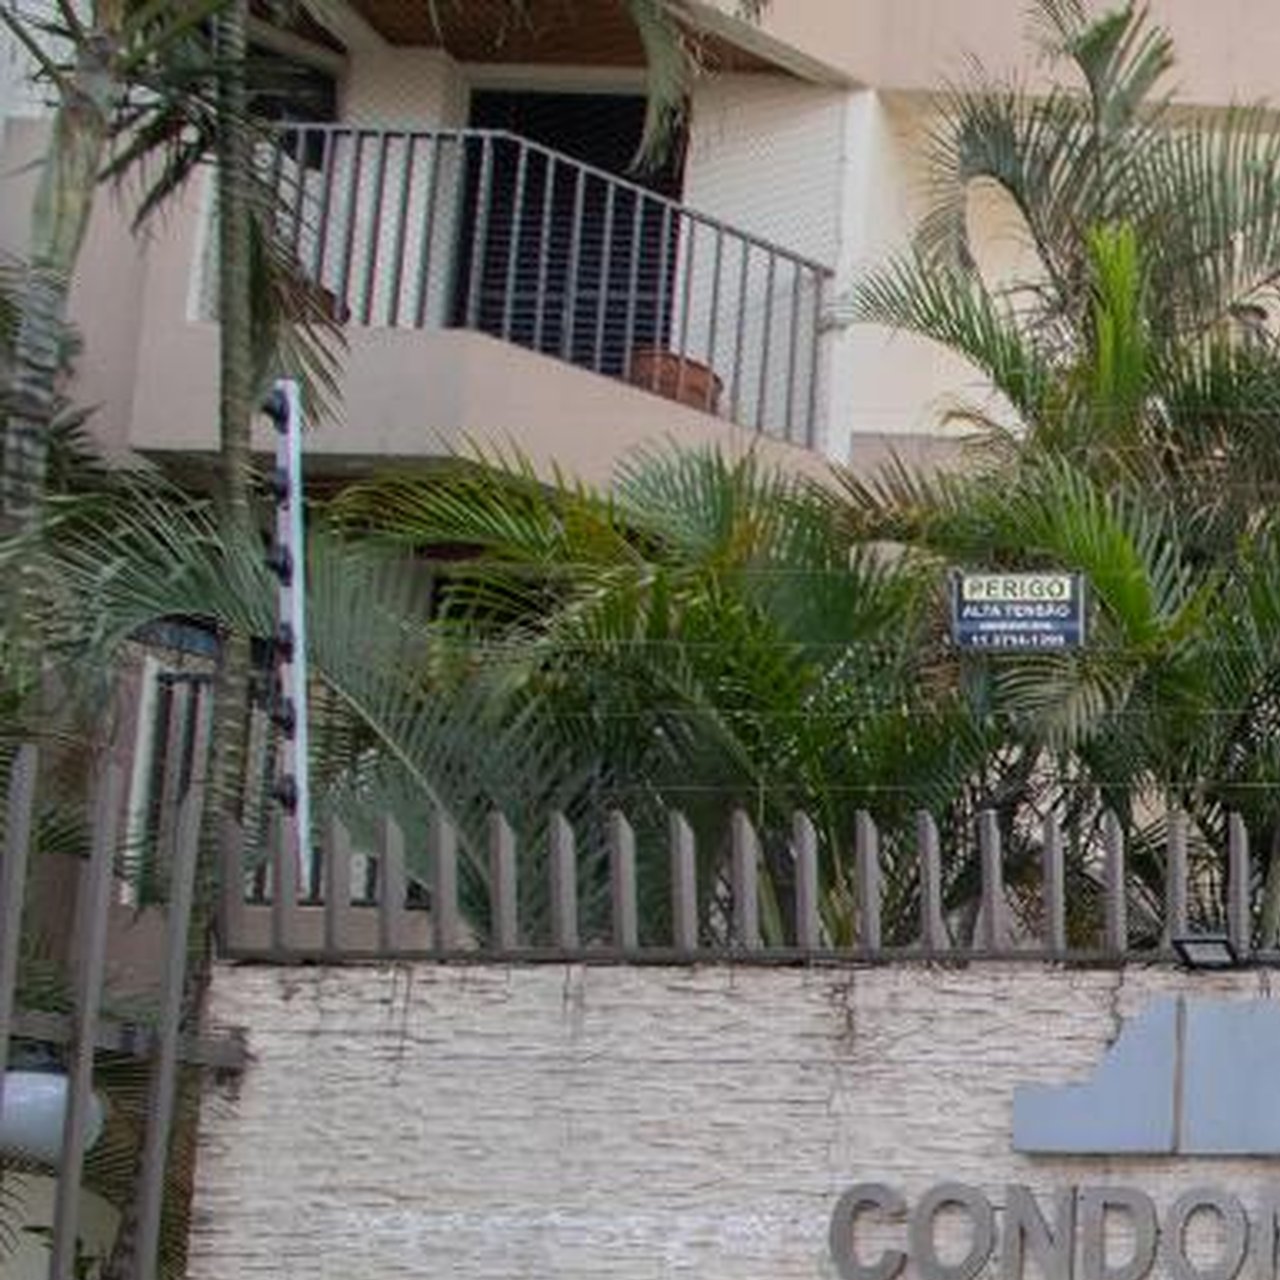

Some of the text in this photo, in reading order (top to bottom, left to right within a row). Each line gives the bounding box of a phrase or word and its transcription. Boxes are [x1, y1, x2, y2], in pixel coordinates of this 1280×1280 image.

[968, 579, 1065, 598] PERIGO
[962, 602, 1070, 618] ALTA TENSÃO
